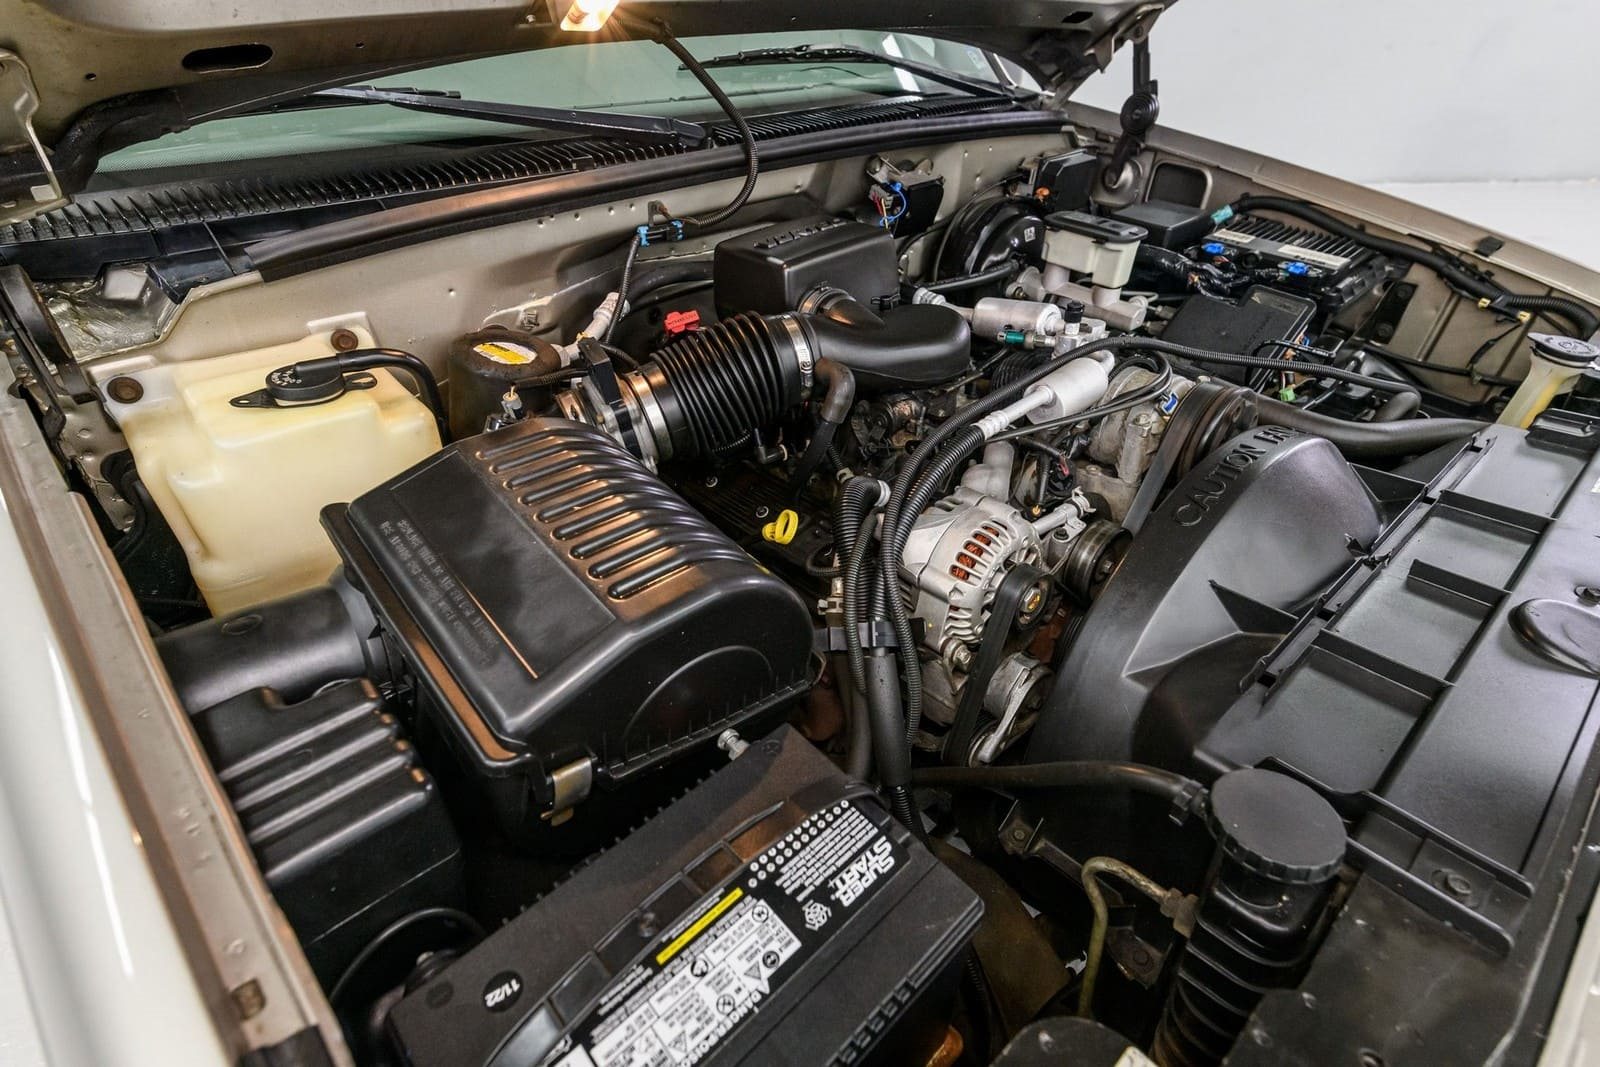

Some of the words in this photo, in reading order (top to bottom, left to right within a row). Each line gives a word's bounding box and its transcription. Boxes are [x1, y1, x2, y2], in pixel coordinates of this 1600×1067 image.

[1175, 443, 1267, 527] CAUTION
[833, 835, 893, 899] START
[839, 855, 895, 908] SUPER
[484, 978, 521, 1008] 11/22
